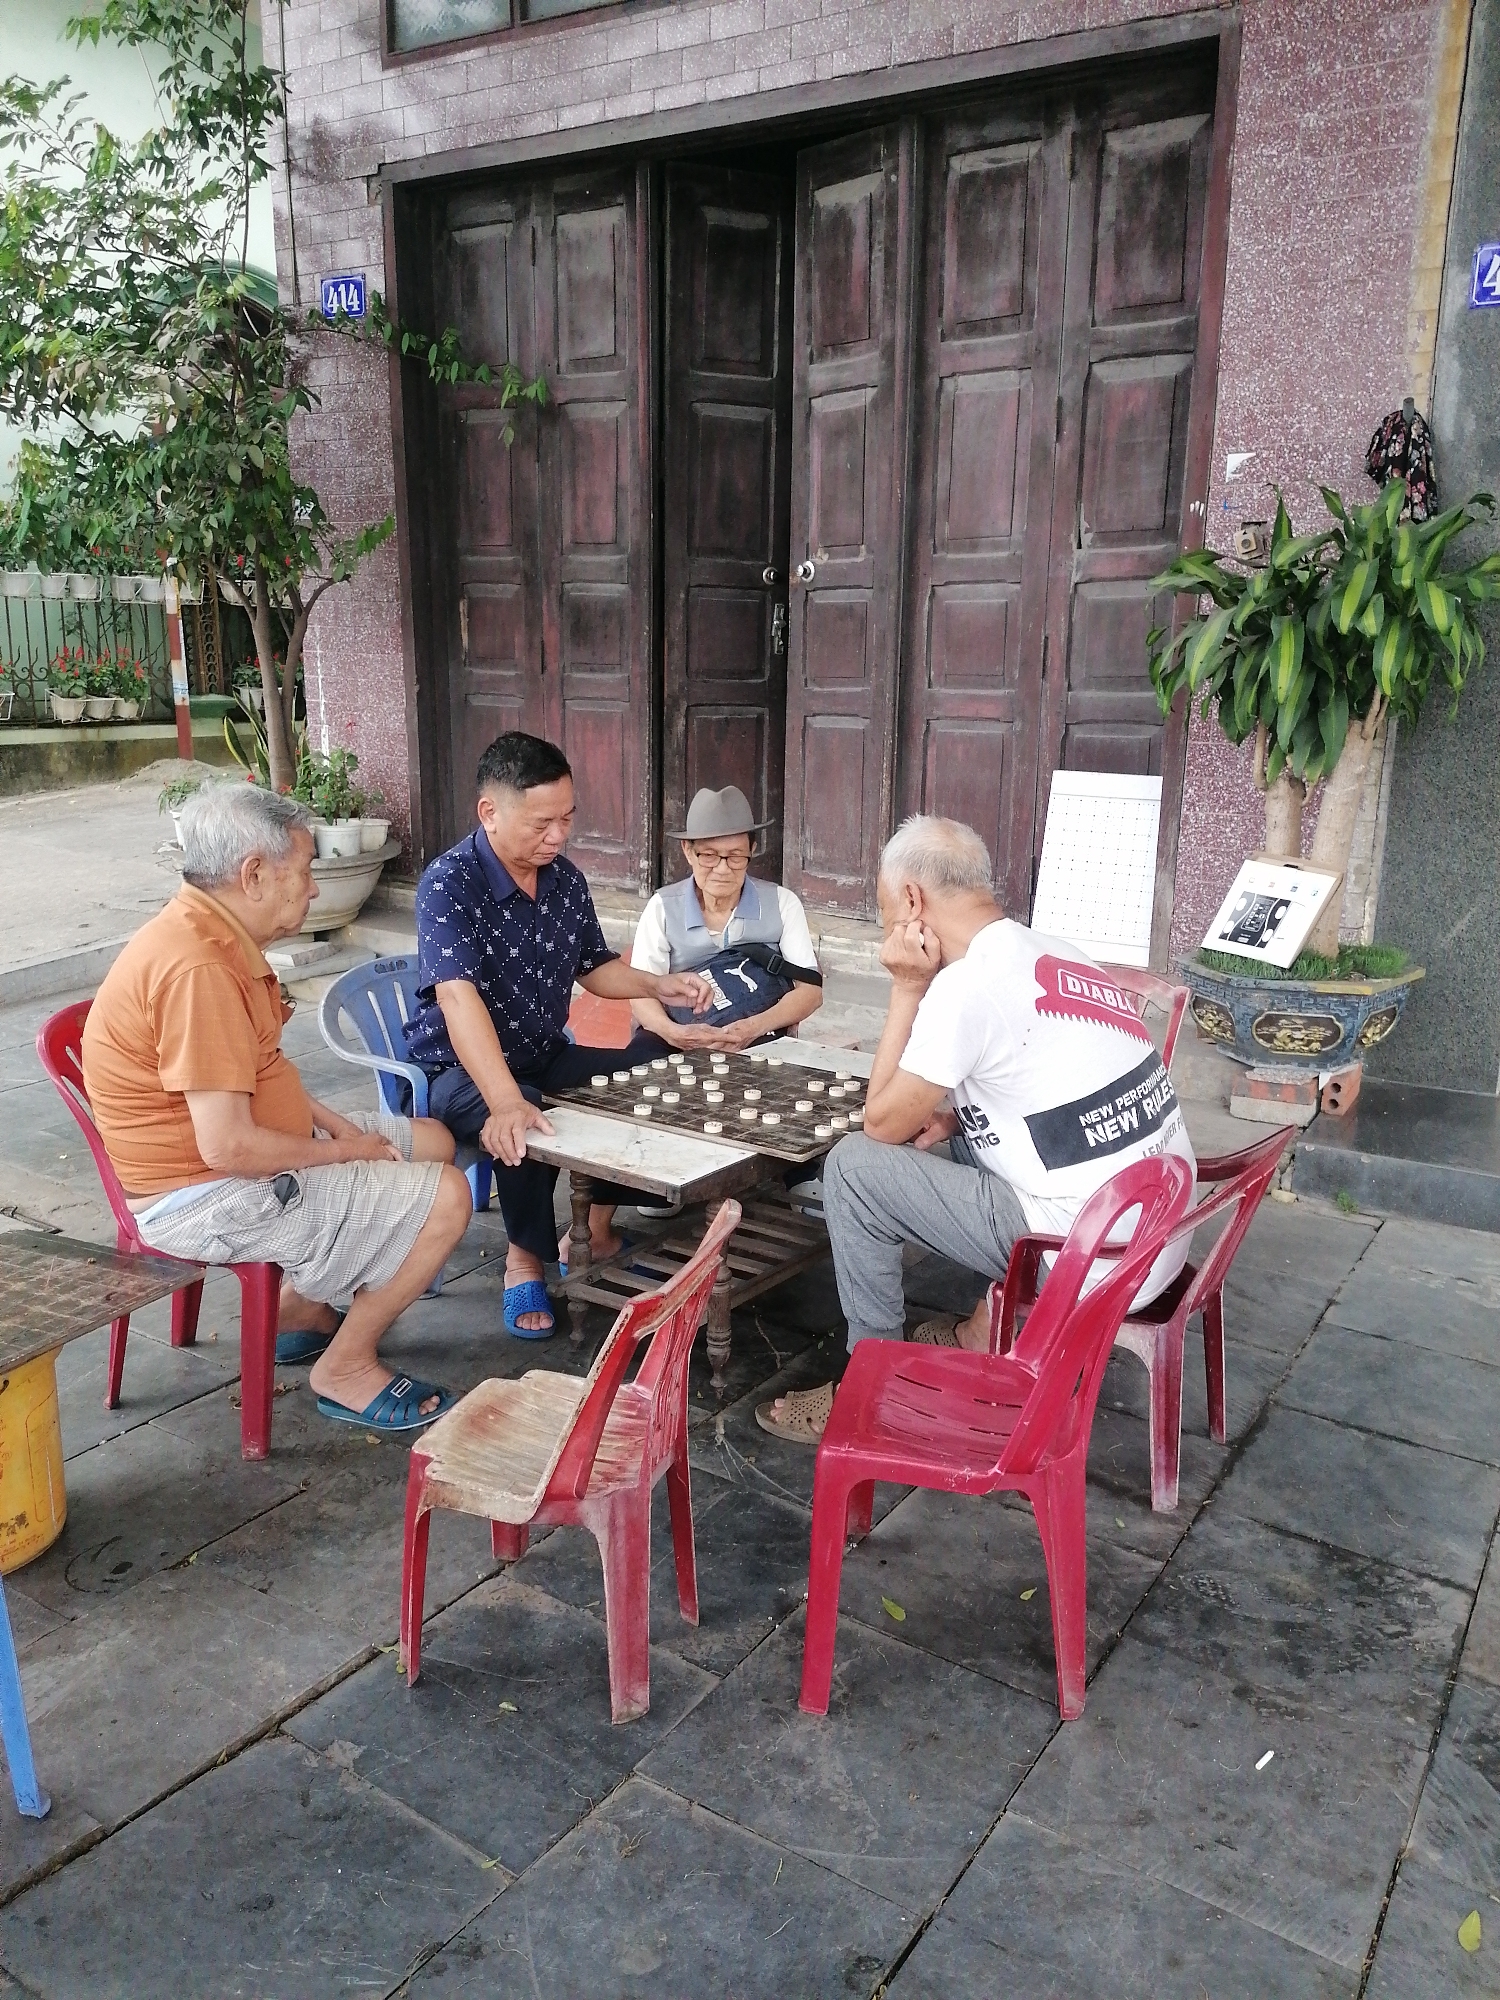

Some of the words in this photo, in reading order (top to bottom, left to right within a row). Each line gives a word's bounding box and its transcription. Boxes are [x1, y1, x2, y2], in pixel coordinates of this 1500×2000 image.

[327, 283, 360, 313] 414
[1078, 1103, 1114, 1126] NEW
[1085, 1107, 1139, 1147] NEW
